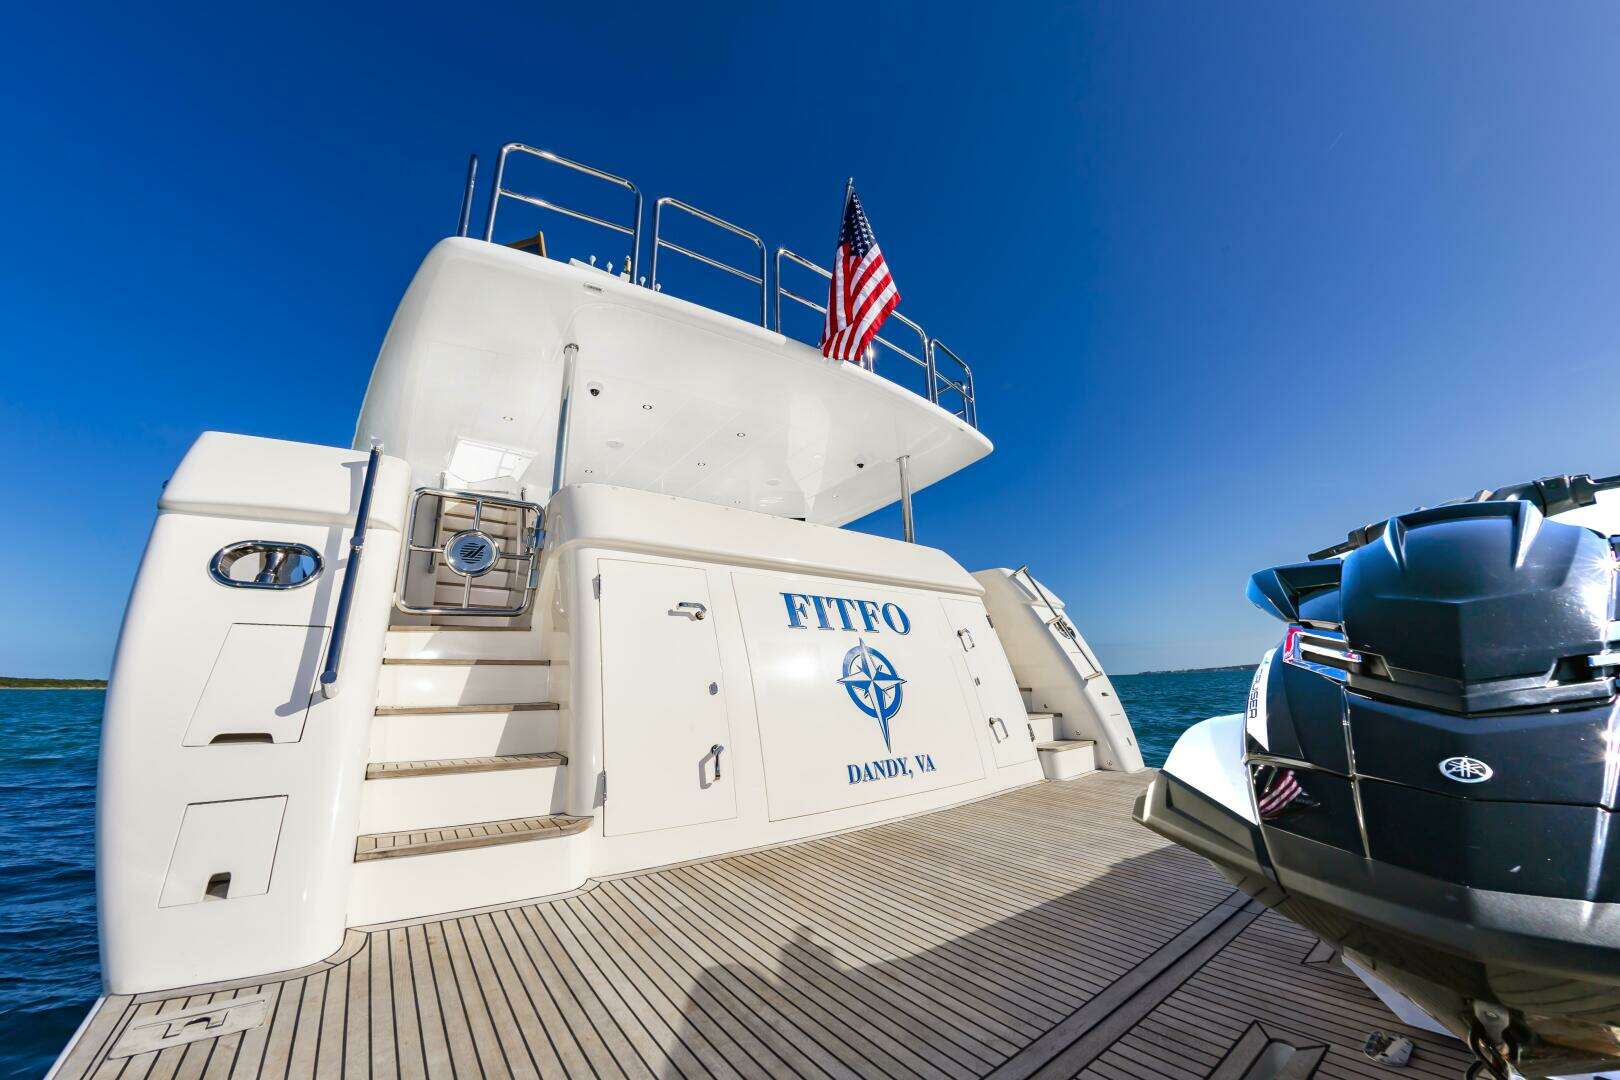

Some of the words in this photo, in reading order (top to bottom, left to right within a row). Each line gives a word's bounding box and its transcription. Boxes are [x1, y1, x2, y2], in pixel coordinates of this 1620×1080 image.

[779, 592, 911, 635] FITFO
[847, 757, 914, 785] DANDY,
[915, 753, 936, 773] VA
